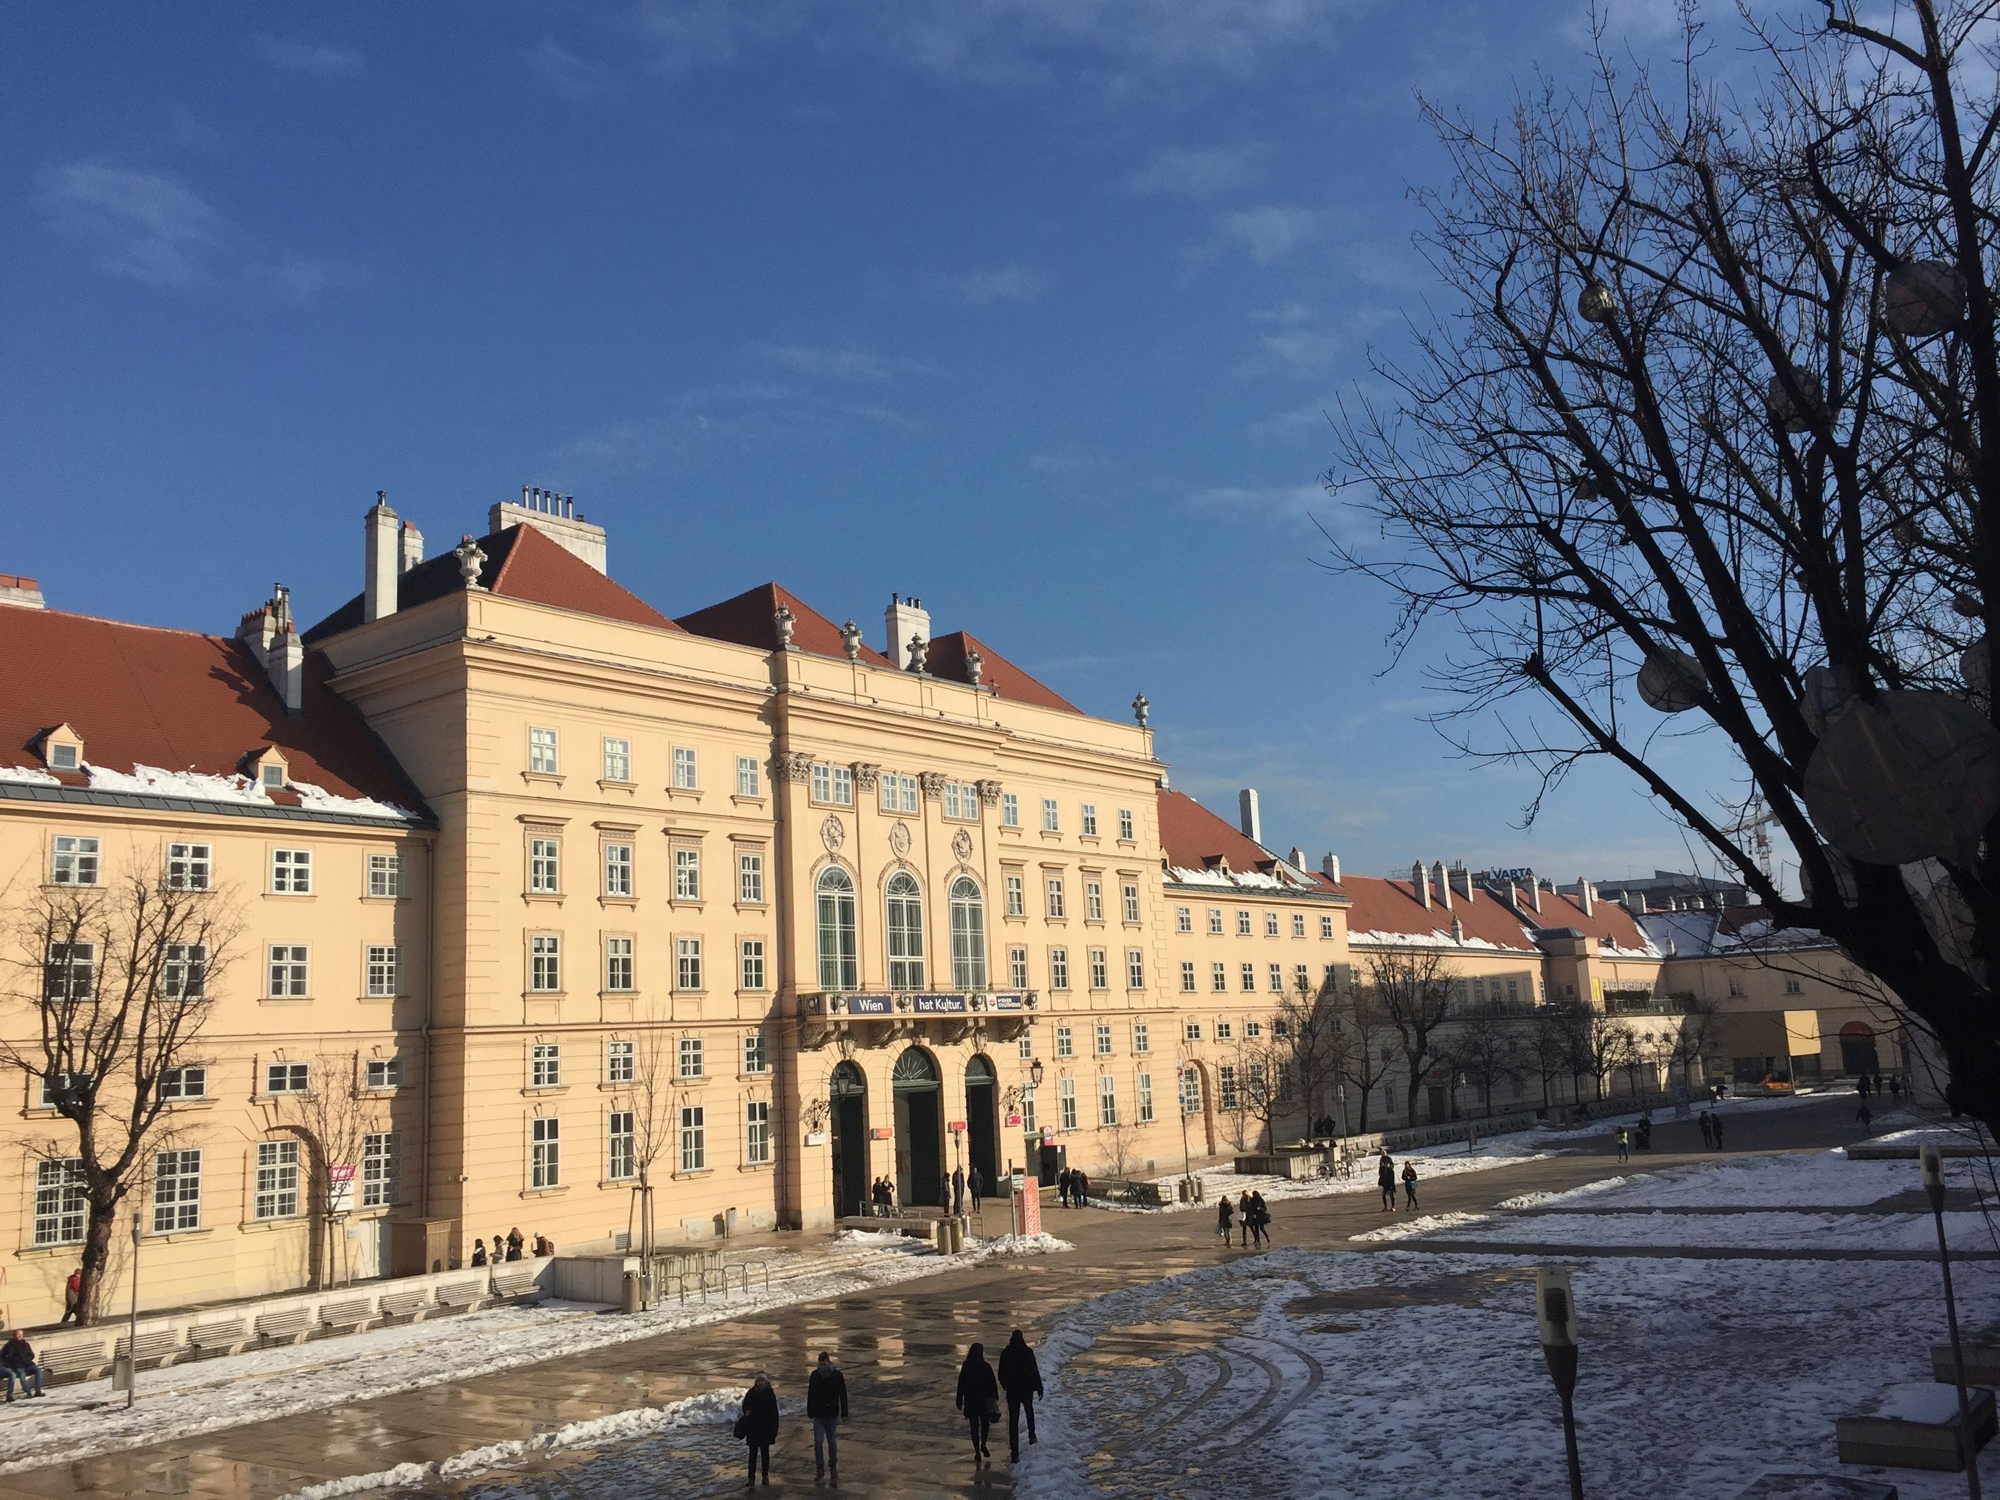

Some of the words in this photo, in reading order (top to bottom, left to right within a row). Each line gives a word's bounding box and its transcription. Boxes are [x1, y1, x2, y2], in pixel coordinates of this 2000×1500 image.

[1493, 867, 1533, 879] VARTA
[860, 1000, 883, 1011] Wien
[919, 999, 933, 1010] hat
[935, 998, 962, 1010] Kultur.
